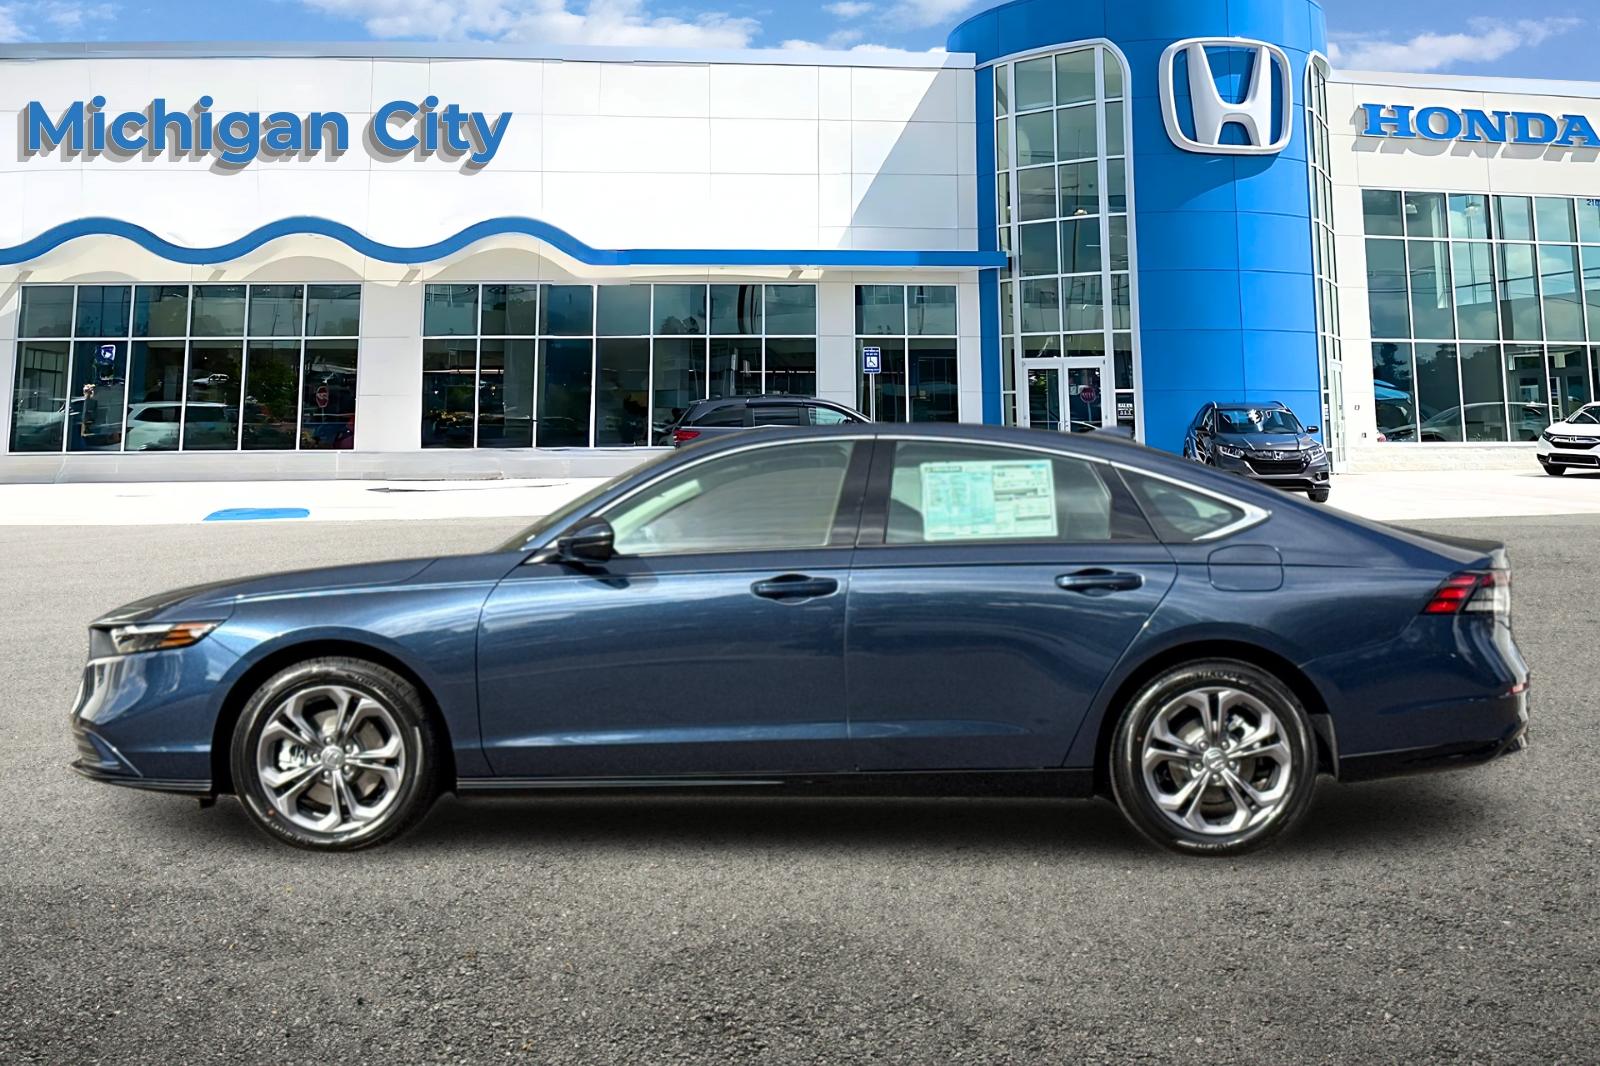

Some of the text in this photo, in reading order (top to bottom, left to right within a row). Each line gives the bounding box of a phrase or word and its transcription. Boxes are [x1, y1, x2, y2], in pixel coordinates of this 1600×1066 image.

[28, 95, 513, 163] Michigan City
[1361, 103, 1600, 147] HONDA
